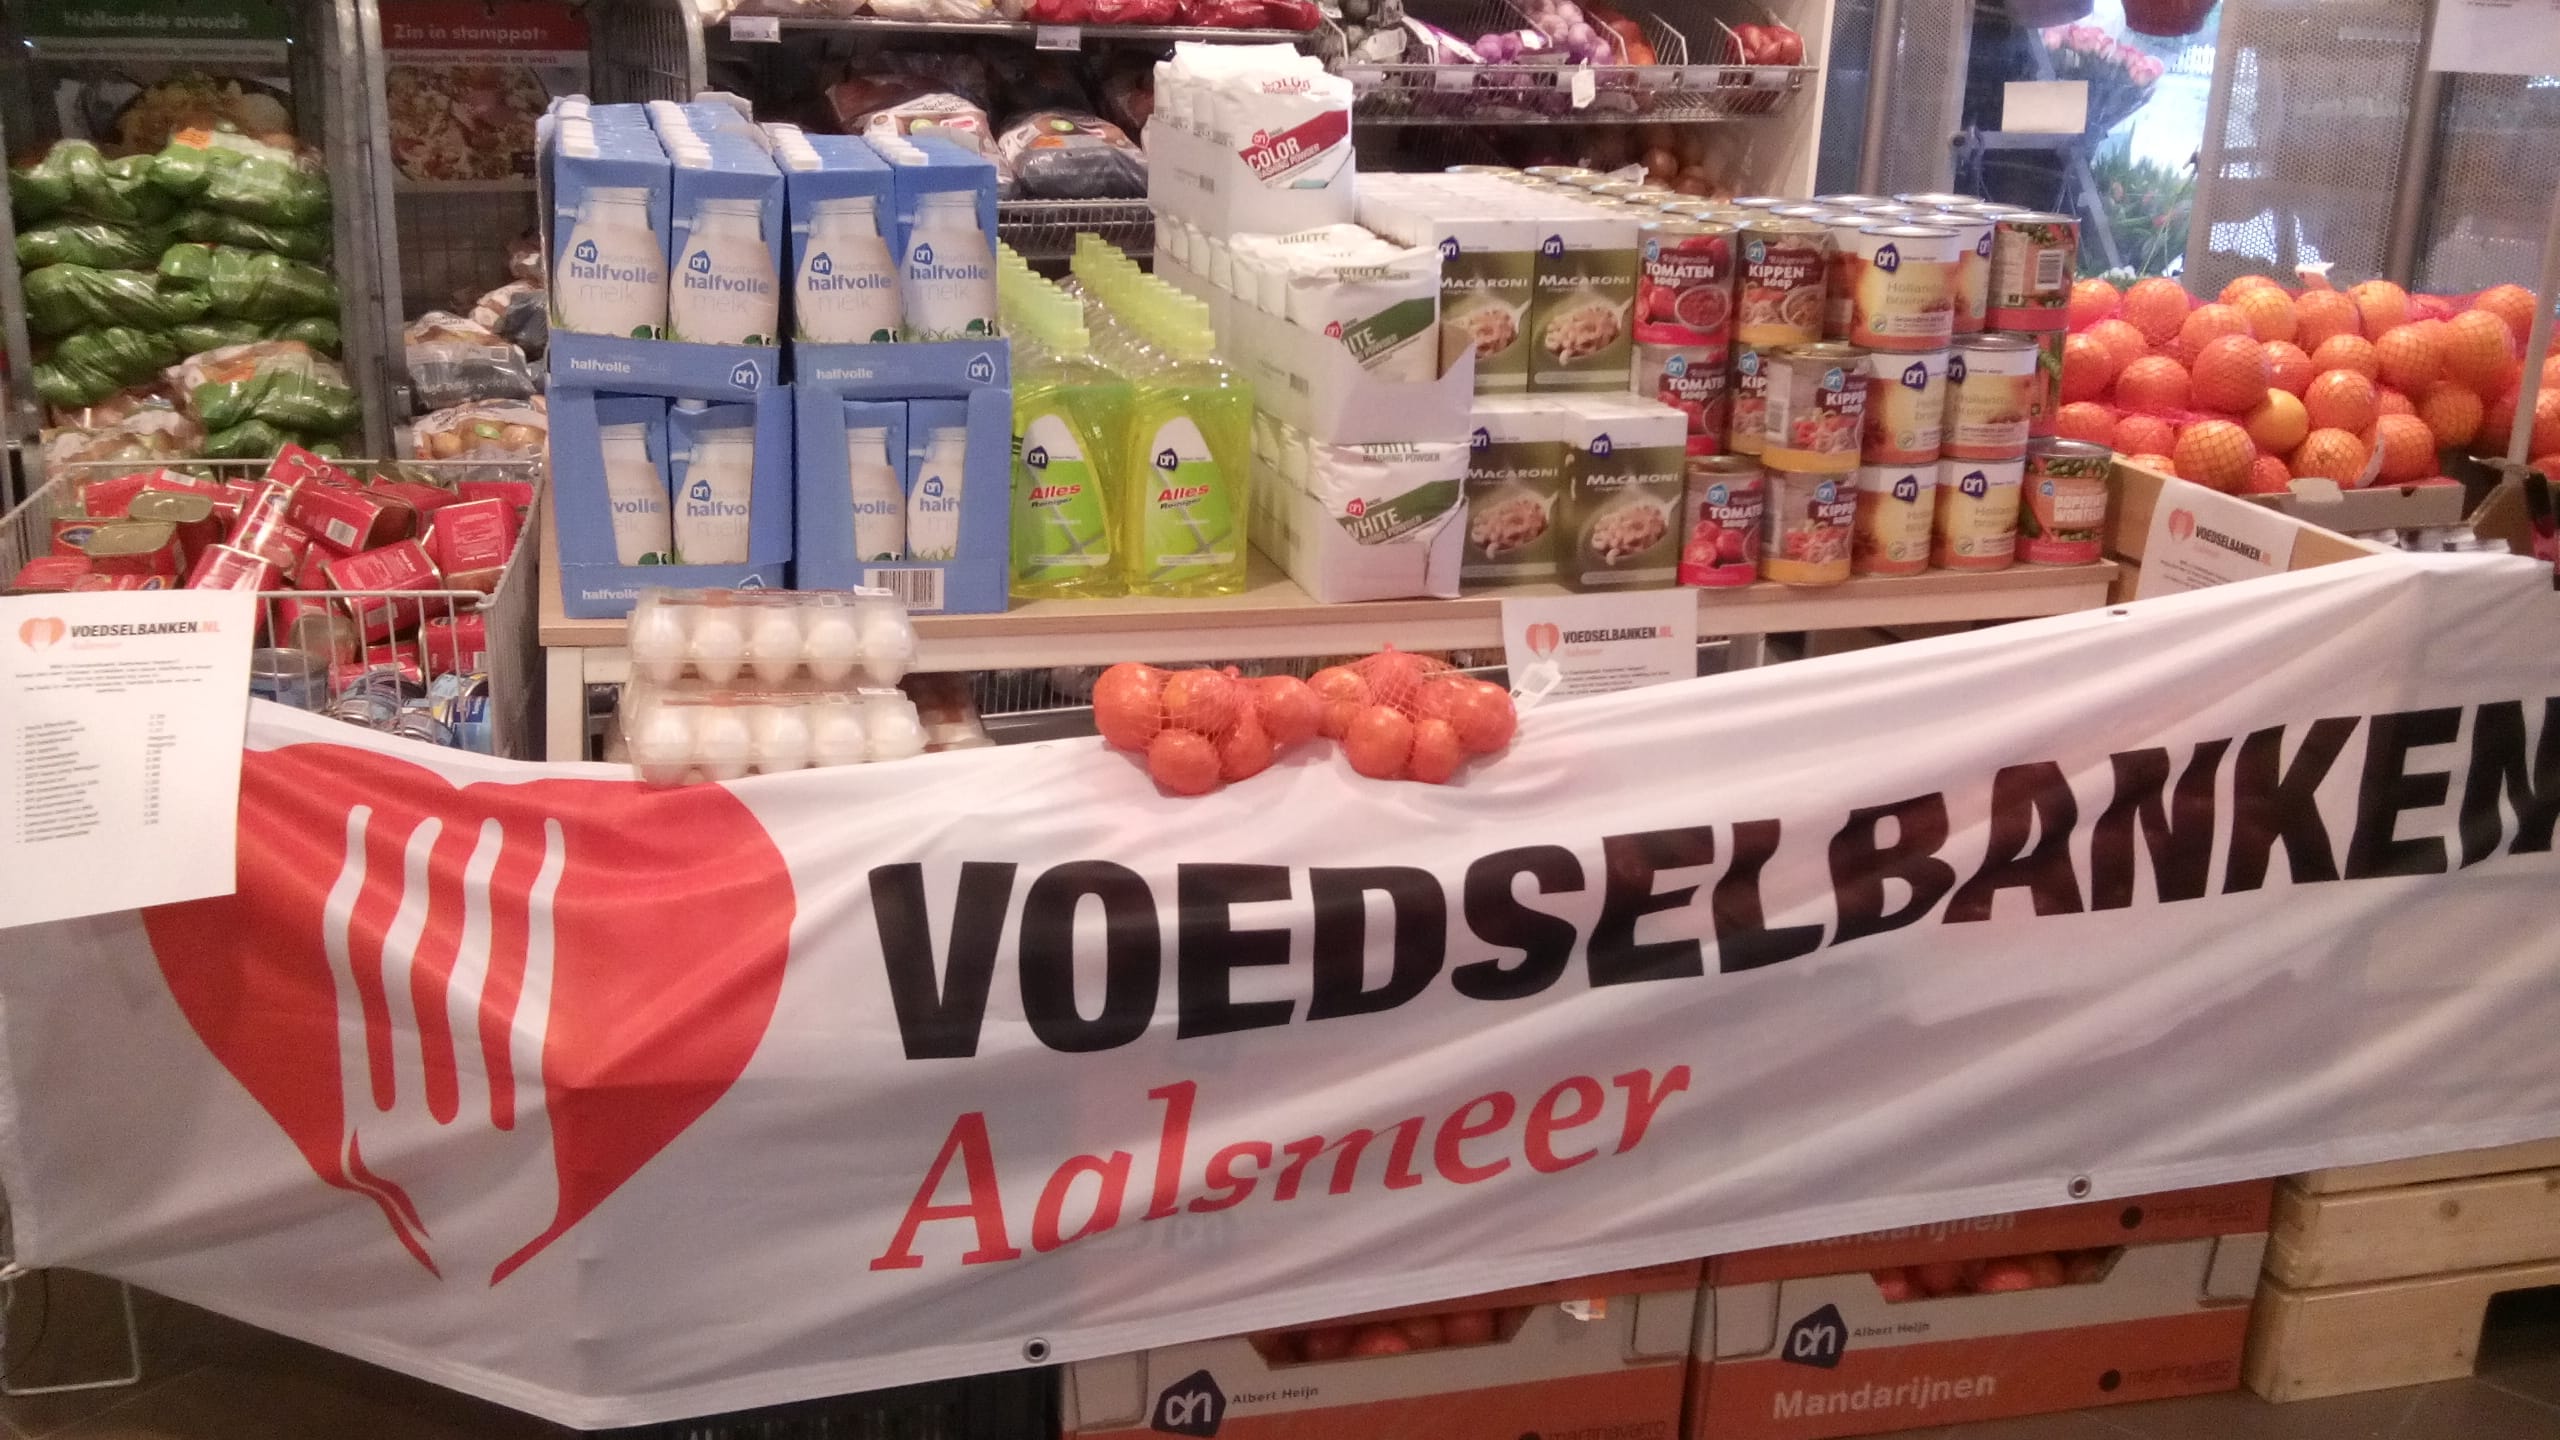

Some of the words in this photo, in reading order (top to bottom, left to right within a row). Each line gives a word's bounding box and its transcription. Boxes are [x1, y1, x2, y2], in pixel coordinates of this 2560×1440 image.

[1248, 137, 1300, 170] COLOR
[570, 261, 659, 283] halfvolle
[910, 264, 990, 280] halfvolle
[1646, 262, 1714, 278] TOMATEN
[1749, 264, 1805, 278] KIPPEN
[684, 272, 769, 294] halfvolle
[808, 274, 893, 291] halfvolle
[1538, 275, 1631, 287] MACARONI
[1654, 277, 1681, 288] soep
[1763, 278, 1793, 290] soep
[570, 357, 631, 374] halfvolle
[816, 368, 873, 381] halfvolle
[1741, 375, 1768, 388] KIP
[1363, 454, 1403, 463] WASHING
[1405, 453, 1440, 462] POWDER
[1468, 468, 1559, 480] MACARONI
[1586, 472, 1680, 486] MACARONI
[1028, 484, 1082, 501] Alles
[1157, 484, 1210, 502] Alles
[613, 498, 663, 514] volle
[687, 500, 749, 517] halfvo
[852, 500, 898, 515] volle
[1031, 497, 1073, 509] Reiniger
[1160, 498, 1202, 510] Reiniger
[1345, 507, 1401, 538] WHITE
[868, 695, 2560, 1060] VOEDSELBANKEN
[868, 1064, 1694, 1273] Aalsmeer
[1854, 1326, 1892, 1337] Albert
[1897, 1321, 1930, 1333] Heijn
[1231, 1392, 1276, 1405] Albert
[1281, 1386, 1319, 1399] Heijn
[1773, 1375, 1997, 1421] Mandarijnen
